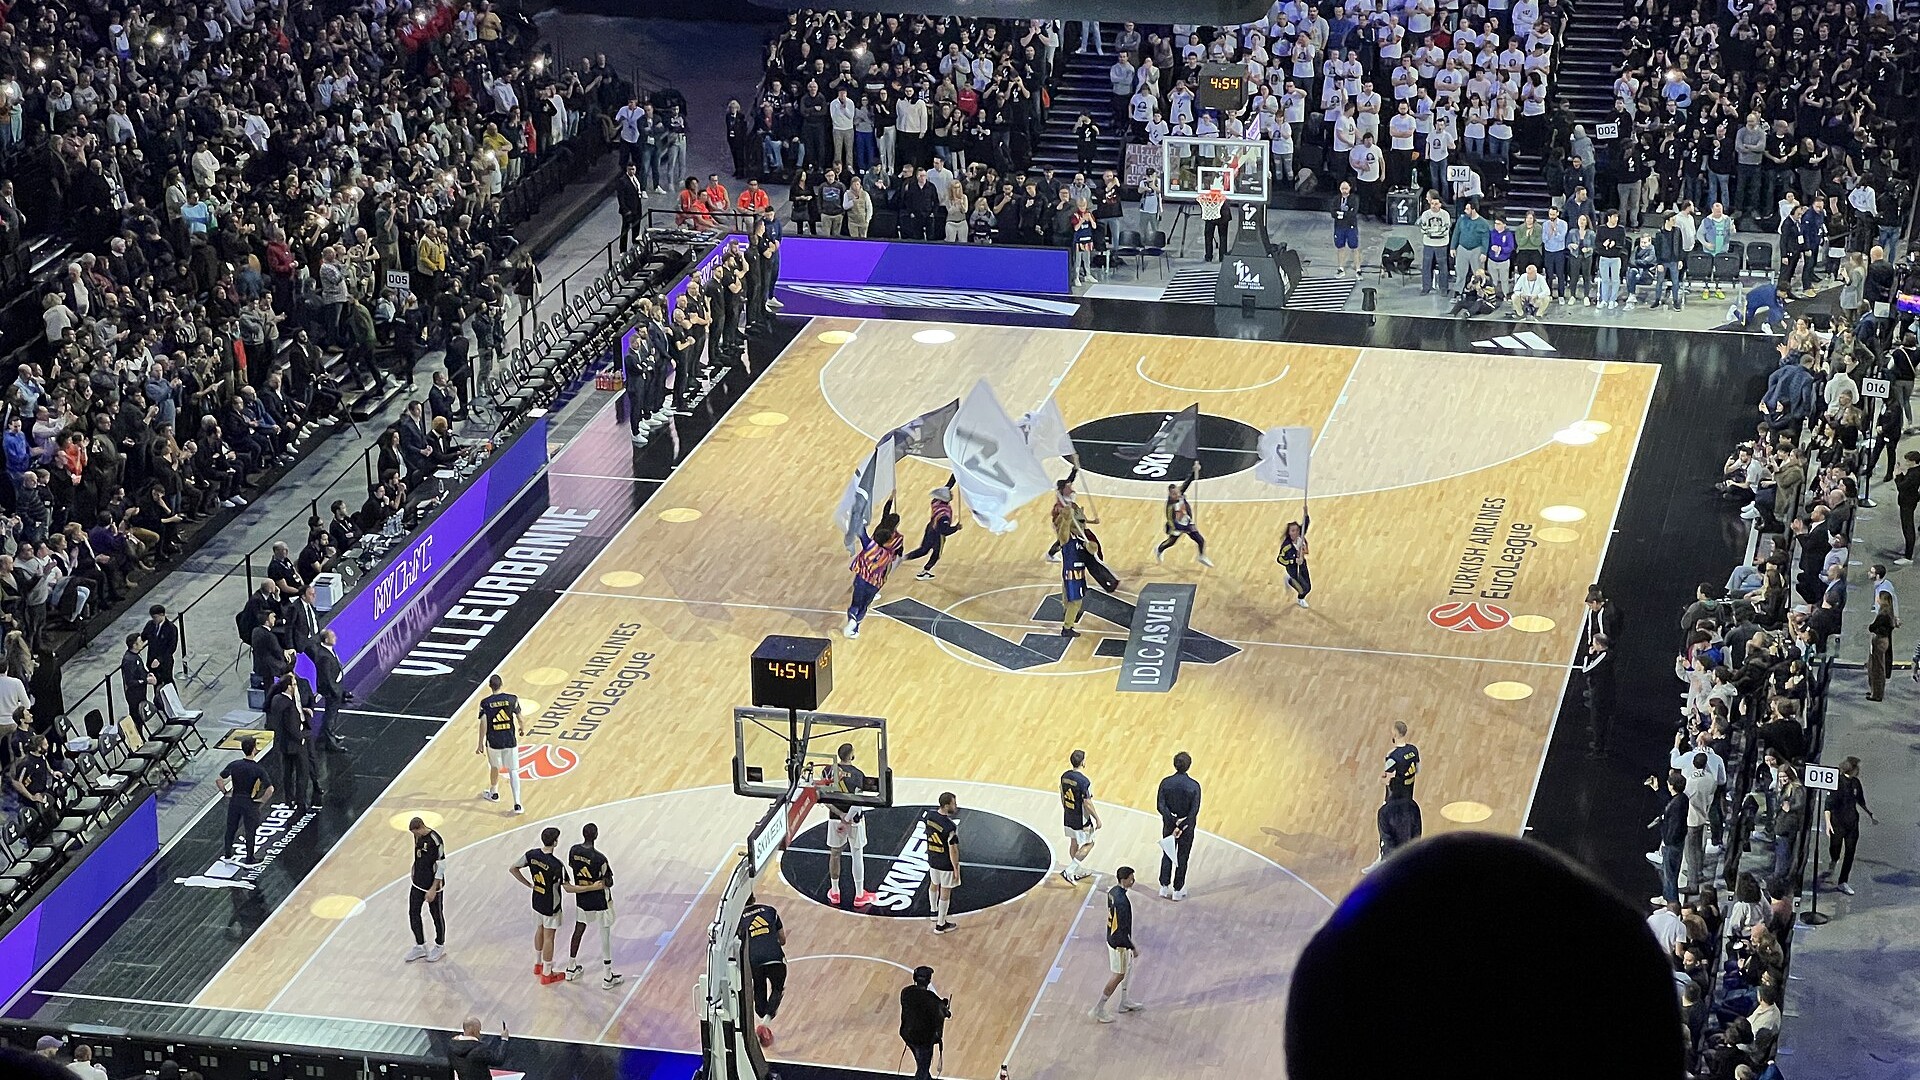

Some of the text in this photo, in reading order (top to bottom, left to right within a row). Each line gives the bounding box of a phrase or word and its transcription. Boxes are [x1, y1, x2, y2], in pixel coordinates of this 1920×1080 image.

[1210, 77, 1239, 89] 4:54
[1598, 127, 1618, 136] 002
[389, 274, 407, 284] 005
[1866, 381, 1886, 394] 016
[1448, 497, 1506, 596] TURKISH AIRLINES
[1480, 522, 1538, 600] EuroLeague
[390, 505, 601, 677] VILLEURBANNE
[1130, 598, 1177, 685] LDLC ASVEL
[526, 622, 642, 737] TURKISH AIRLINES
[768, 661, 809, 680] 4:54
[558, 651, 656, 741] EuroLeague
[1809, 770, 1834, 784] 018
